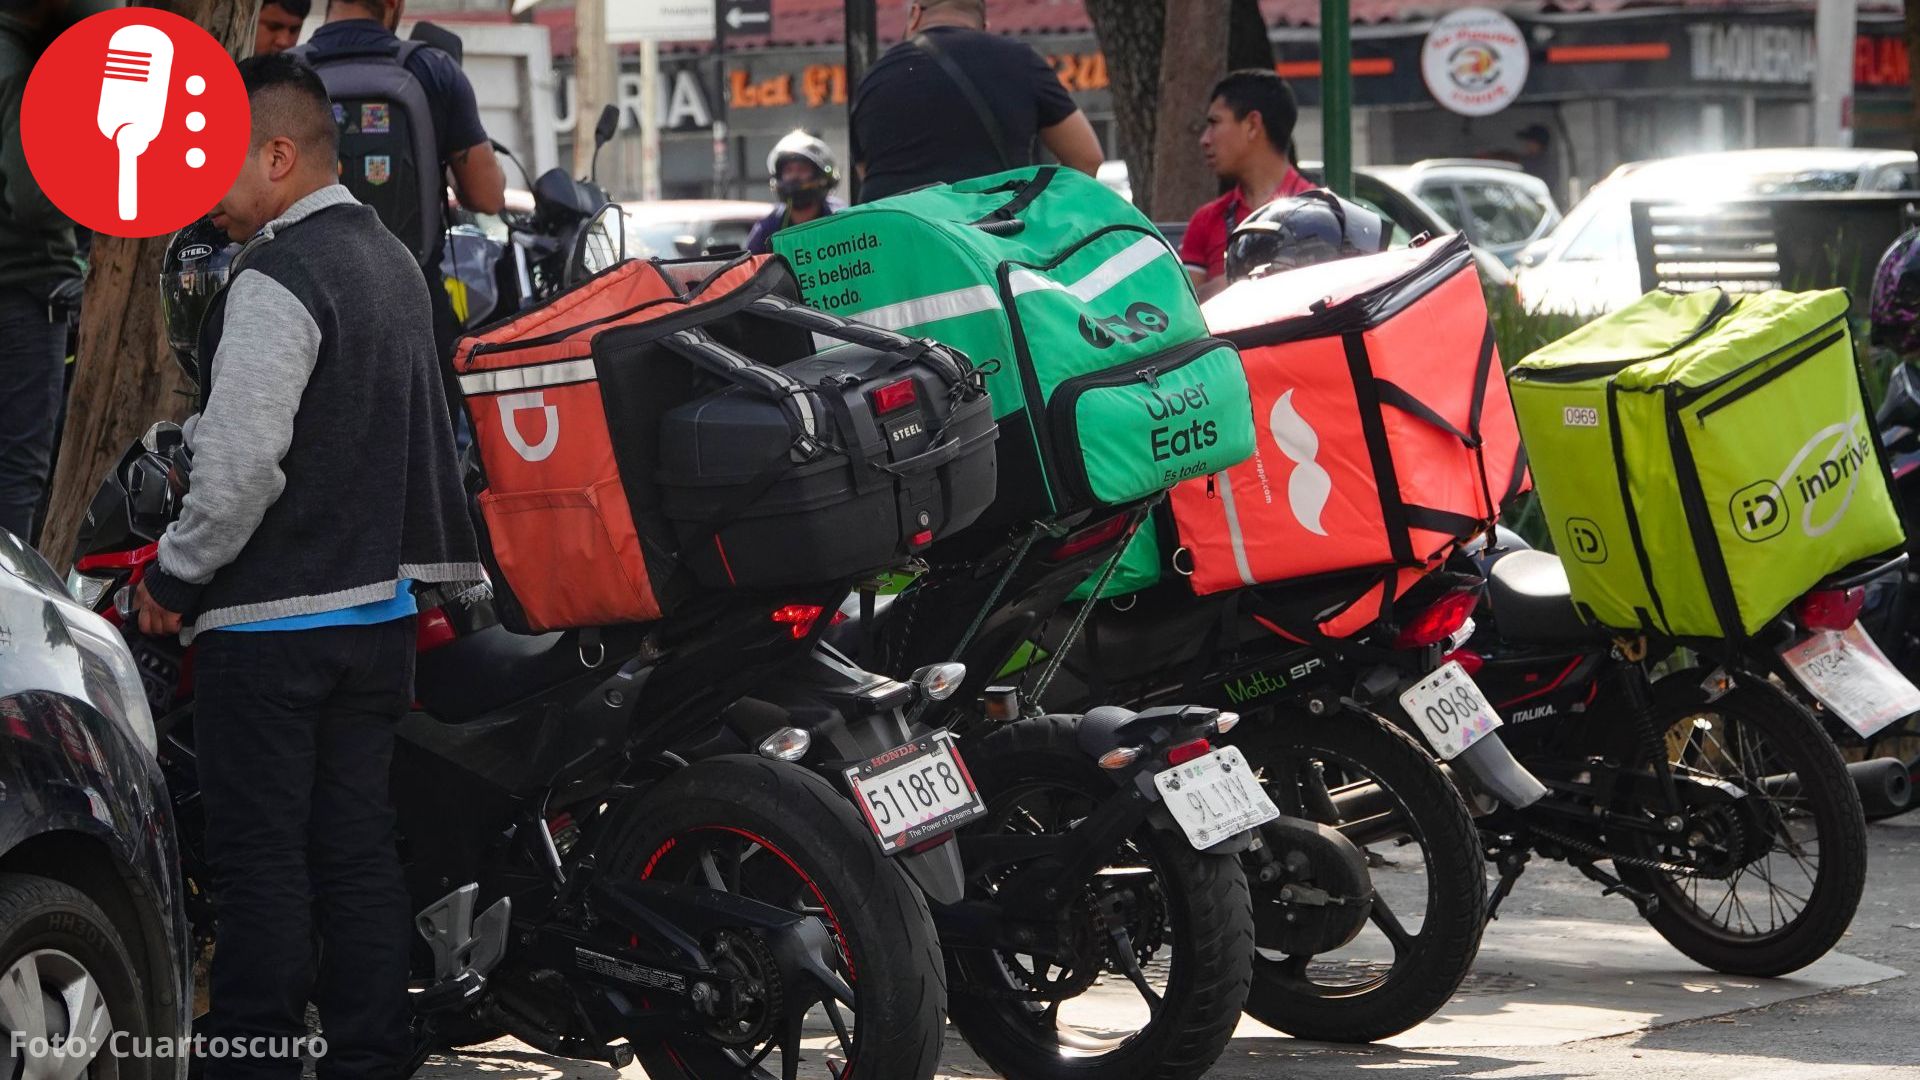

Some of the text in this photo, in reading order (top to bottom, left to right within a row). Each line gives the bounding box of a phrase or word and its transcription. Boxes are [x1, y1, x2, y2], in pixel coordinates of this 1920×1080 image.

[181, 247, 208, 259] STEEL
[795, 233, 882, 266] Es comida.
[799, 259, 875, 291] Es bebida.
[823, 288, 862, 310] todo.
[1139, 383, 1210, 421] Uber
[1566, 408, 1597, 425] 0969
[892, 423, 922, 442] STEEL
[1151, 419, 1218, 462] Eats
[1164, 469, 1177, 482] Es
[1796, 435, 1870, 503] inDrive
[1224, 671, 1287, 705] Mottu
[1512, 704, 1554, 724] ITALIKA
[870, 743, 919, 767] HONDA
[867, 761, 960, 825] 5118F8
[908, 829, 922, 838] The
[922, 820, 941, 832] Power
[949, 808, 973, 822] Dreams
